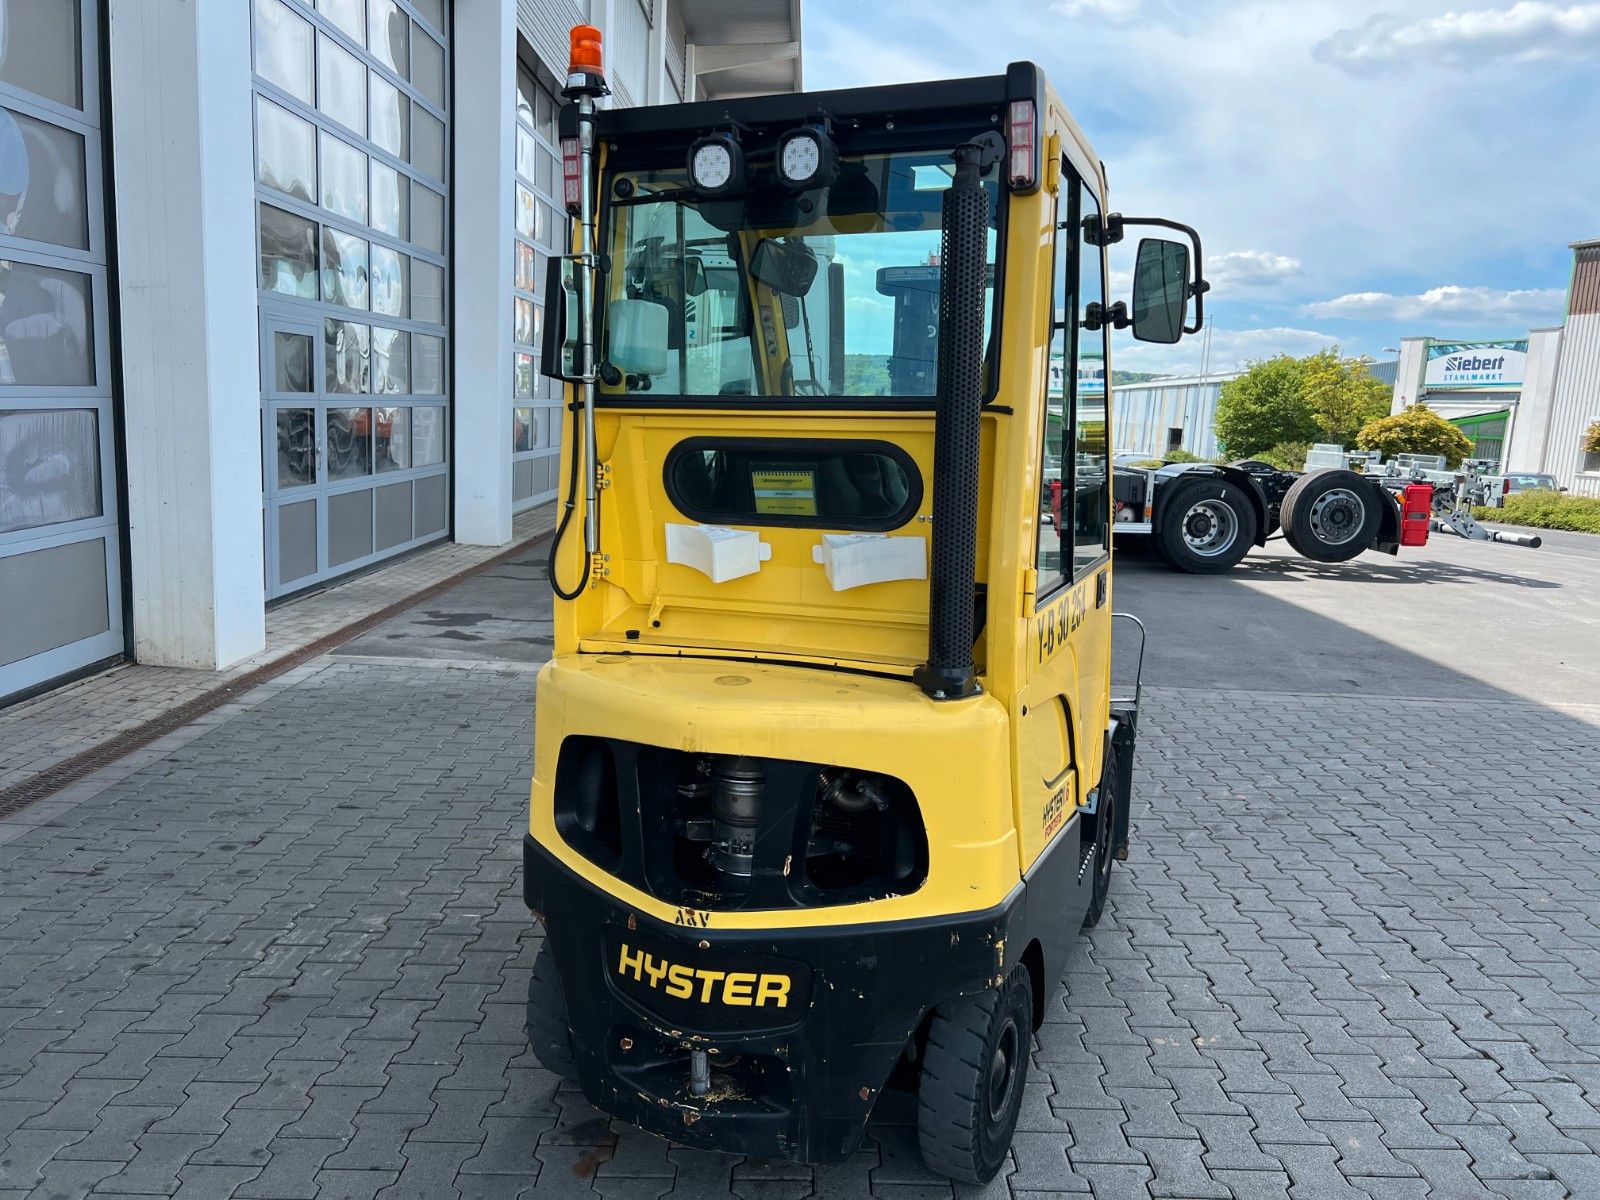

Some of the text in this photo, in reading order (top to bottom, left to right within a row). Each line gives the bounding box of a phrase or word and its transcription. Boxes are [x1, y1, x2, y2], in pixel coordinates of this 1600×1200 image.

[1443, 373, 1503, 381] STAHLMARKT
[1445, 355, 1505, 371] Siebert
[1038, 608, 1055, 665] Y-B
[1058, 595, 1069, 645] 30
[1042, 787, 1064, 829] HYSTER
[618, 943, 791, 1008] HYSTER
